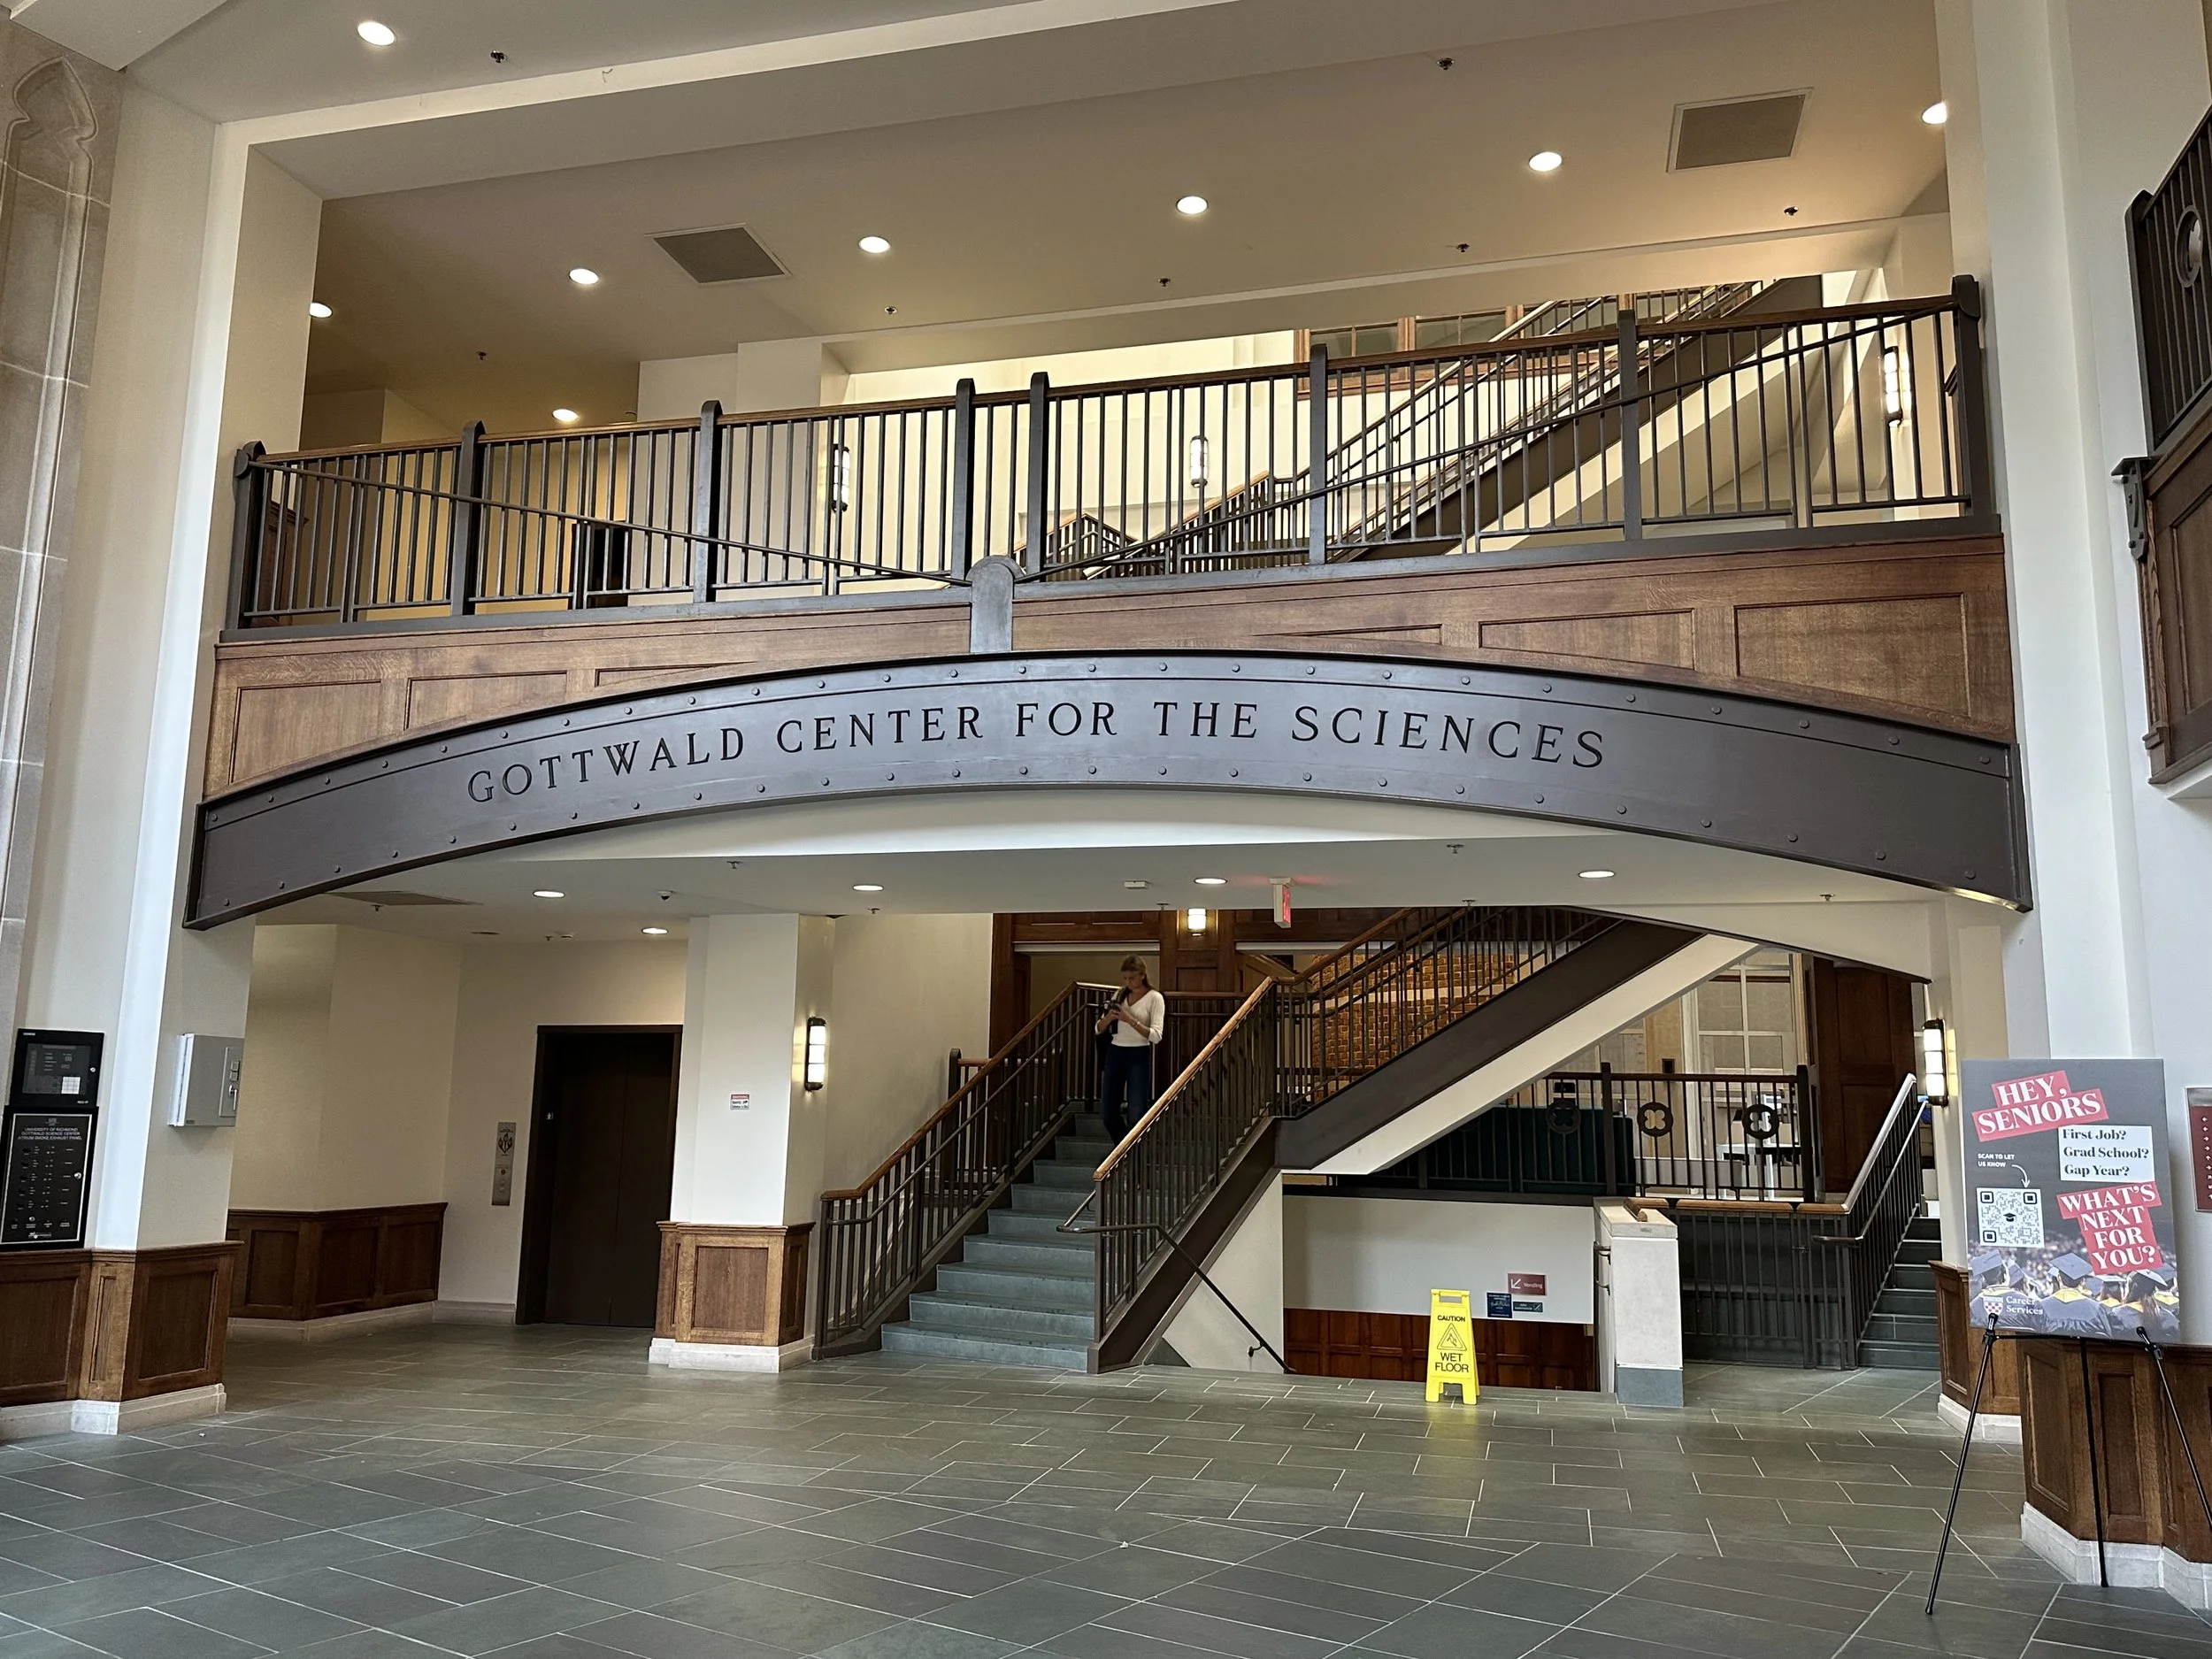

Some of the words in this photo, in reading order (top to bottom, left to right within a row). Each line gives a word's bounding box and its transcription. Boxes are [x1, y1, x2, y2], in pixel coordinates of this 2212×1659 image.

[467, 727, 743, 803] GOTTWALD
[776, 706, 984, 754] CENTER
[1015, 702, 1118, 737] FOR
[1153, 702, 1258, 739] THE
[1291, 705, 1604, 768] SCIENCES
[1996, 1075, 2067, 1106] HEY,
[1978, 1093, 2101, 1134] SENIORS
[2062, 1128, 2093, 1140] First
[2095, 1129, 2126, 1141] Job?
[2063, 1146, 2095, 1157] Grad
[2098, 1147, 2149, 1158] School?
[2064, 1164, 2090, 1178] Gap
[2093, 1164, 2130, 1176] Year?
[2060, 1184, 2156, 1213] WHAT'S
[2080, 1205, 2145, 1231] NEXT
[2094, 1226, 2146, 1249] FOR
[2092, 1245, 2155, 1270] YOU?
[2006, 1295, 2035, 1305] Career
[2006, 1305, 2043, 1315] Services
[1440, 1352, 1463, 1363] WET
[1434, 1363, 1469, 1373] FLOOR
